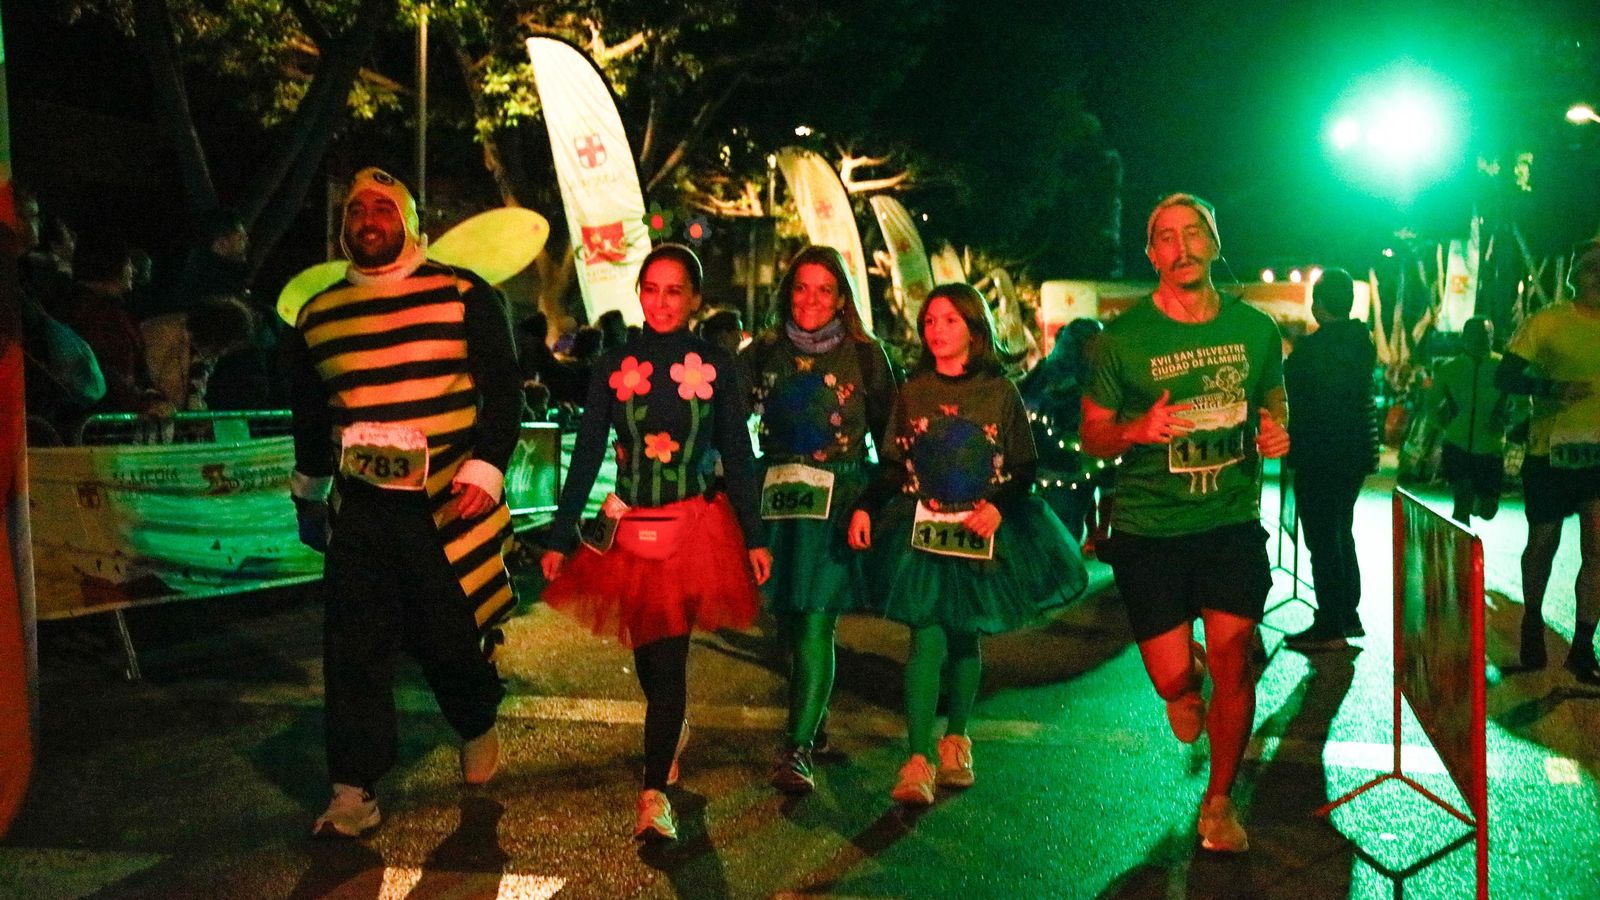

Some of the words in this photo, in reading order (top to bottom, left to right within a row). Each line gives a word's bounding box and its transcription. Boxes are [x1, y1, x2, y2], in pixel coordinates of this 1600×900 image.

[1150, 355, 1172, 368] XVII
[1173, 350, 1195, 363] SAN
[1196, 344, 1246, 358] SILVESTRE
[1151, 362, 1190, 377] CIUDAD
[1191, 358, 1205, 369] DE
[1206, 352, 1247, 366] ALMERÍA
[356, 453, 410, 478] 783
[771, 491, 814, 510] 854
